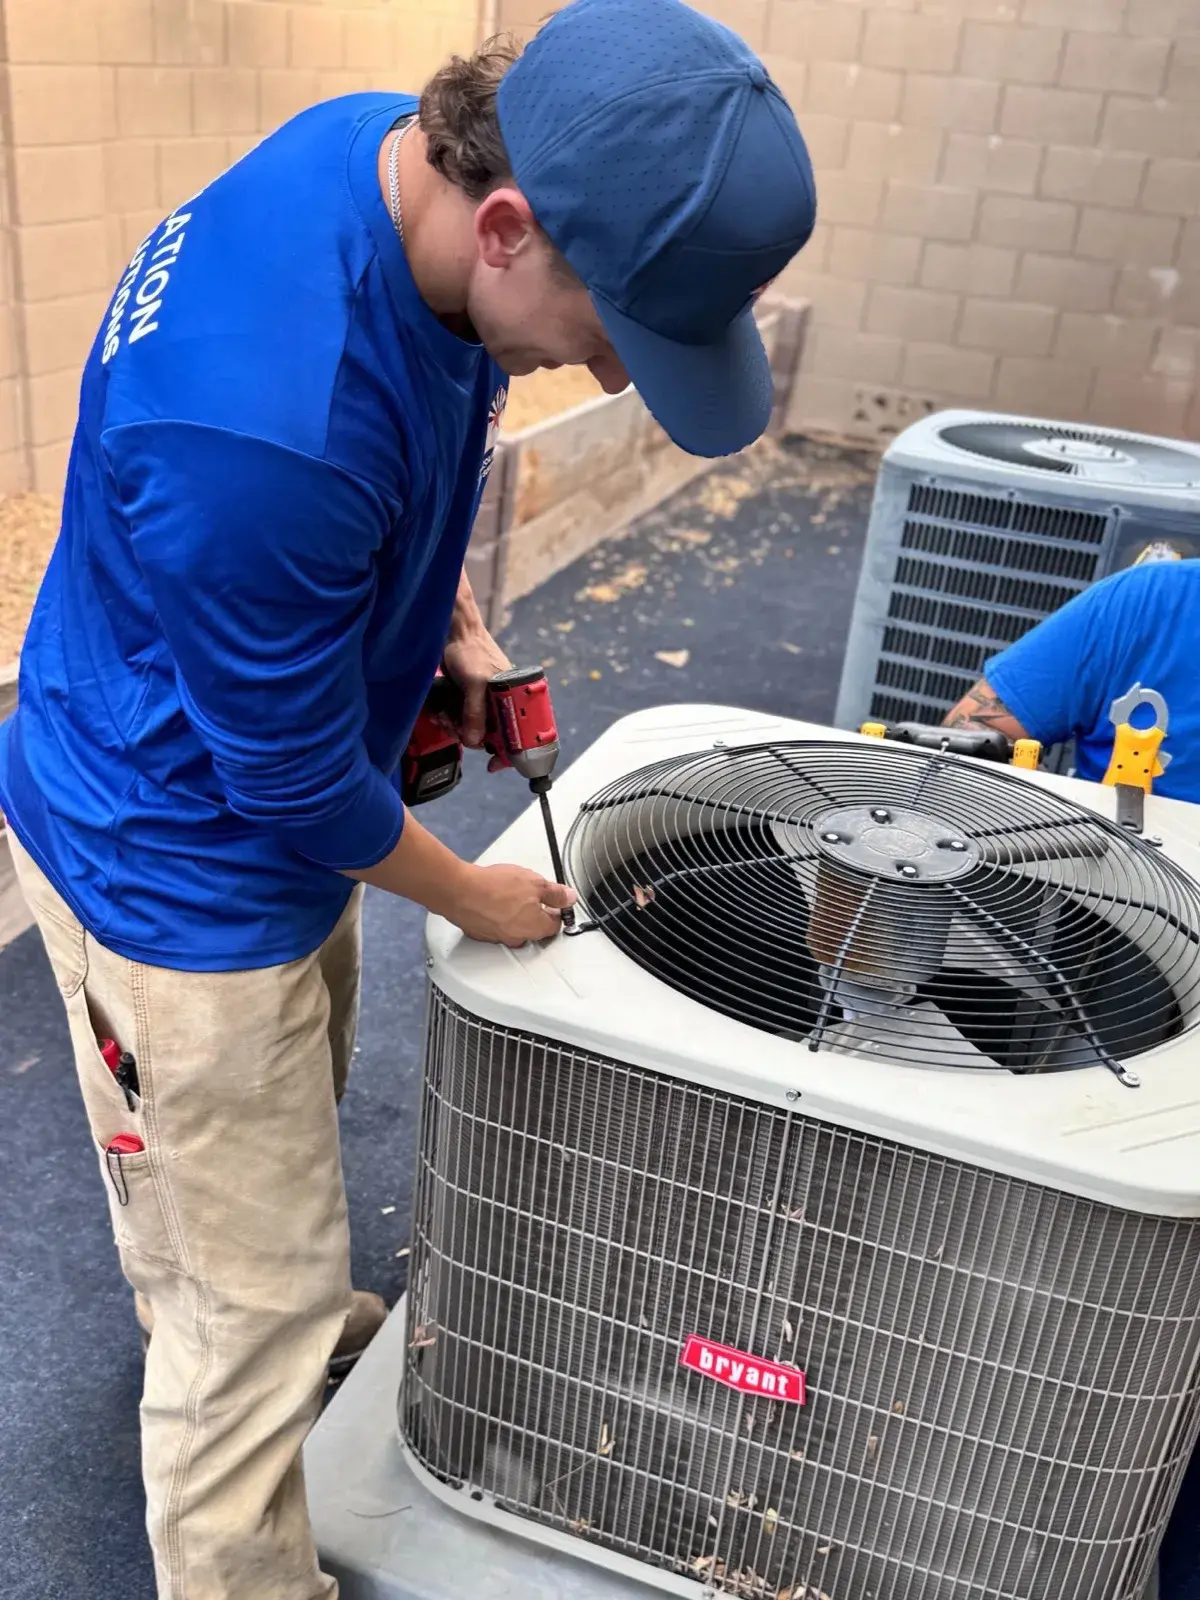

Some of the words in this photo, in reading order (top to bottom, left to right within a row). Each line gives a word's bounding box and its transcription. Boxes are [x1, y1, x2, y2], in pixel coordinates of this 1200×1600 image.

[101, 238, 152, 365] UTIONS
[128, 210, 193, 345] ATION
[699, 1346, 788, 1396] bryant
